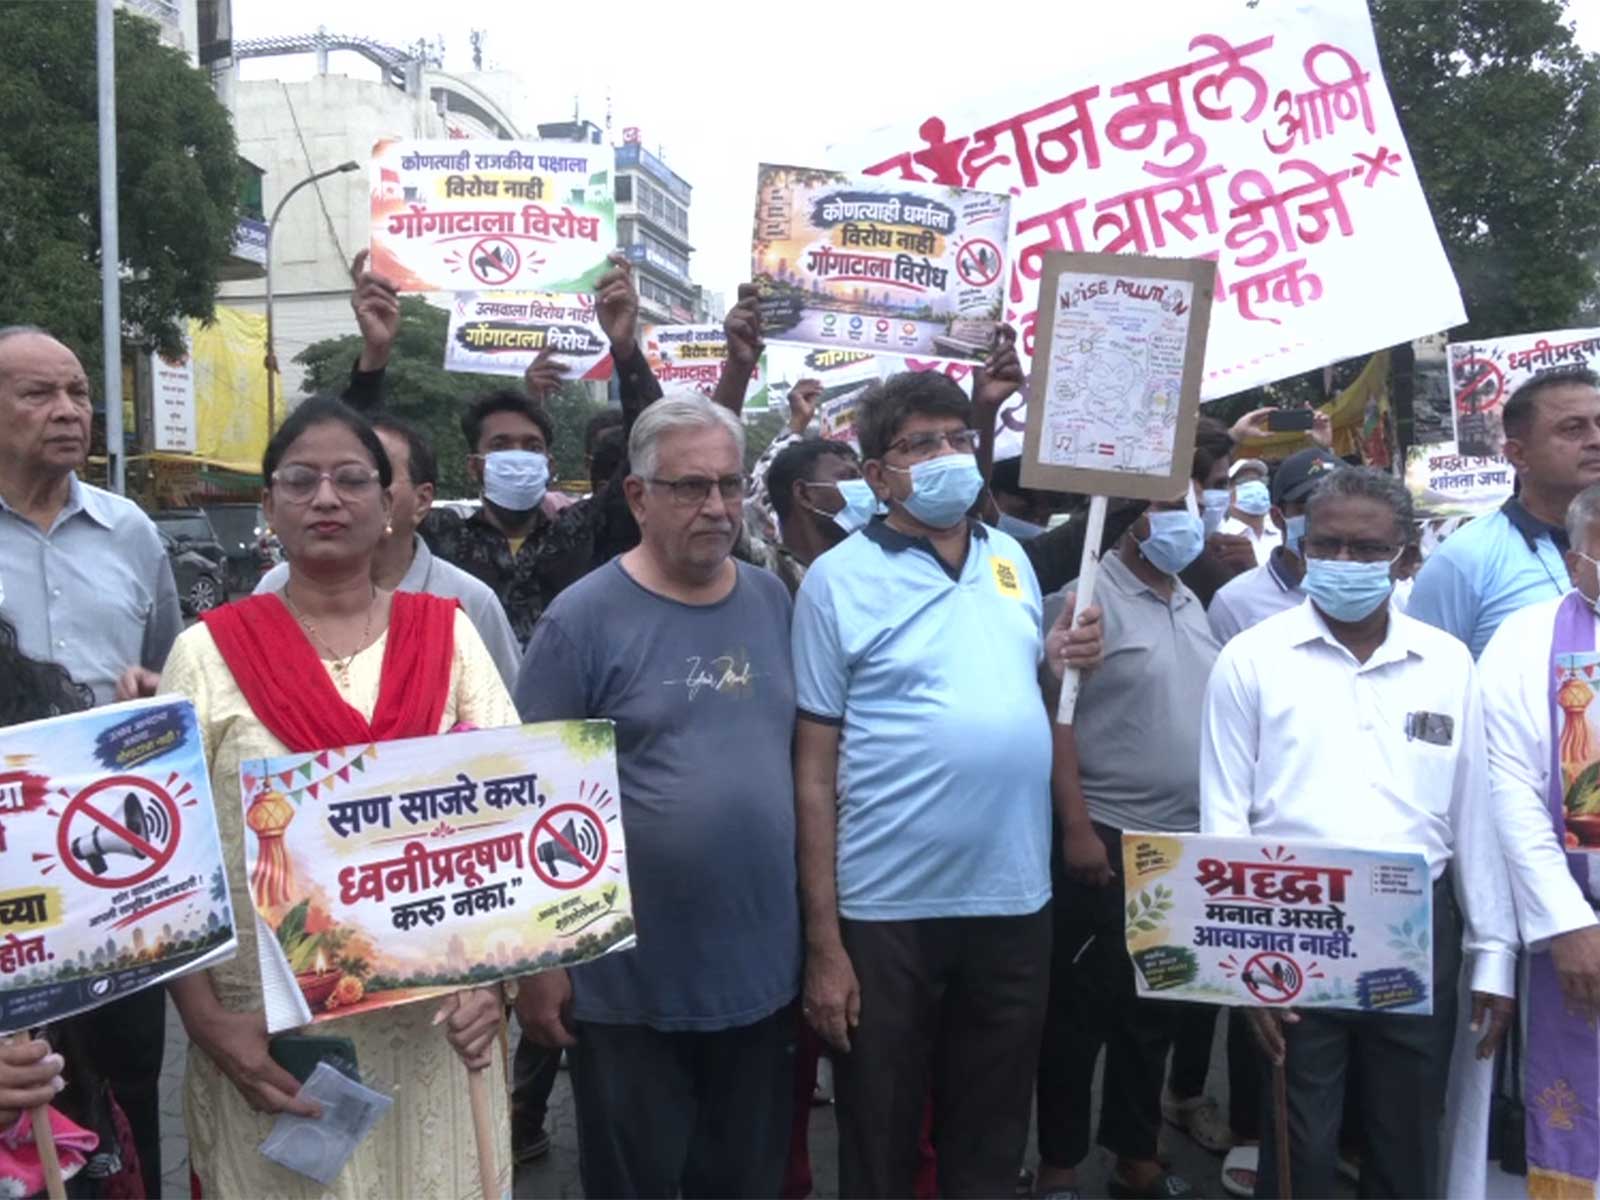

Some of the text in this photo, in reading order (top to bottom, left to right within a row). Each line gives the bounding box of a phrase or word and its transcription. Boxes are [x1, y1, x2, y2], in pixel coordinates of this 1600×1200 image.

[1105, 34, 1274, 177] मुले
[1263, 43, 1375, 153] आणि
[401, 150, 588, 173] कोणत्याही राजकीय पक्षाला
[446, 175, 545, 200] विरोध नाही
[388, 204, 599, 242] गोंगाटाला विरोध
[823, 198, 900, 223] कोणत्याही
[904, 203, 950, 229] धर्माला
[1093, 164, 1227, 253] त्रास
[1225, 159, 1354, 266] डीजे
[841, 222, 936, 255] विरोध नाही
[807, 245, 948, 291] गोंगाटाला विरोध
[530, 300, 566, 320] विरोध
[465, 322, 545, 348] गोंगाटाला
[327, 772, 547, 838] सण साजरे करा,
[338, 832, 524, 905] ध्वनीप्रदूषण
[391, 895, 446, 932] करू
[1205, 904, 1355, 934] मनात असते,
[1193, 926, 1357, 959] आवाजात नाही.
